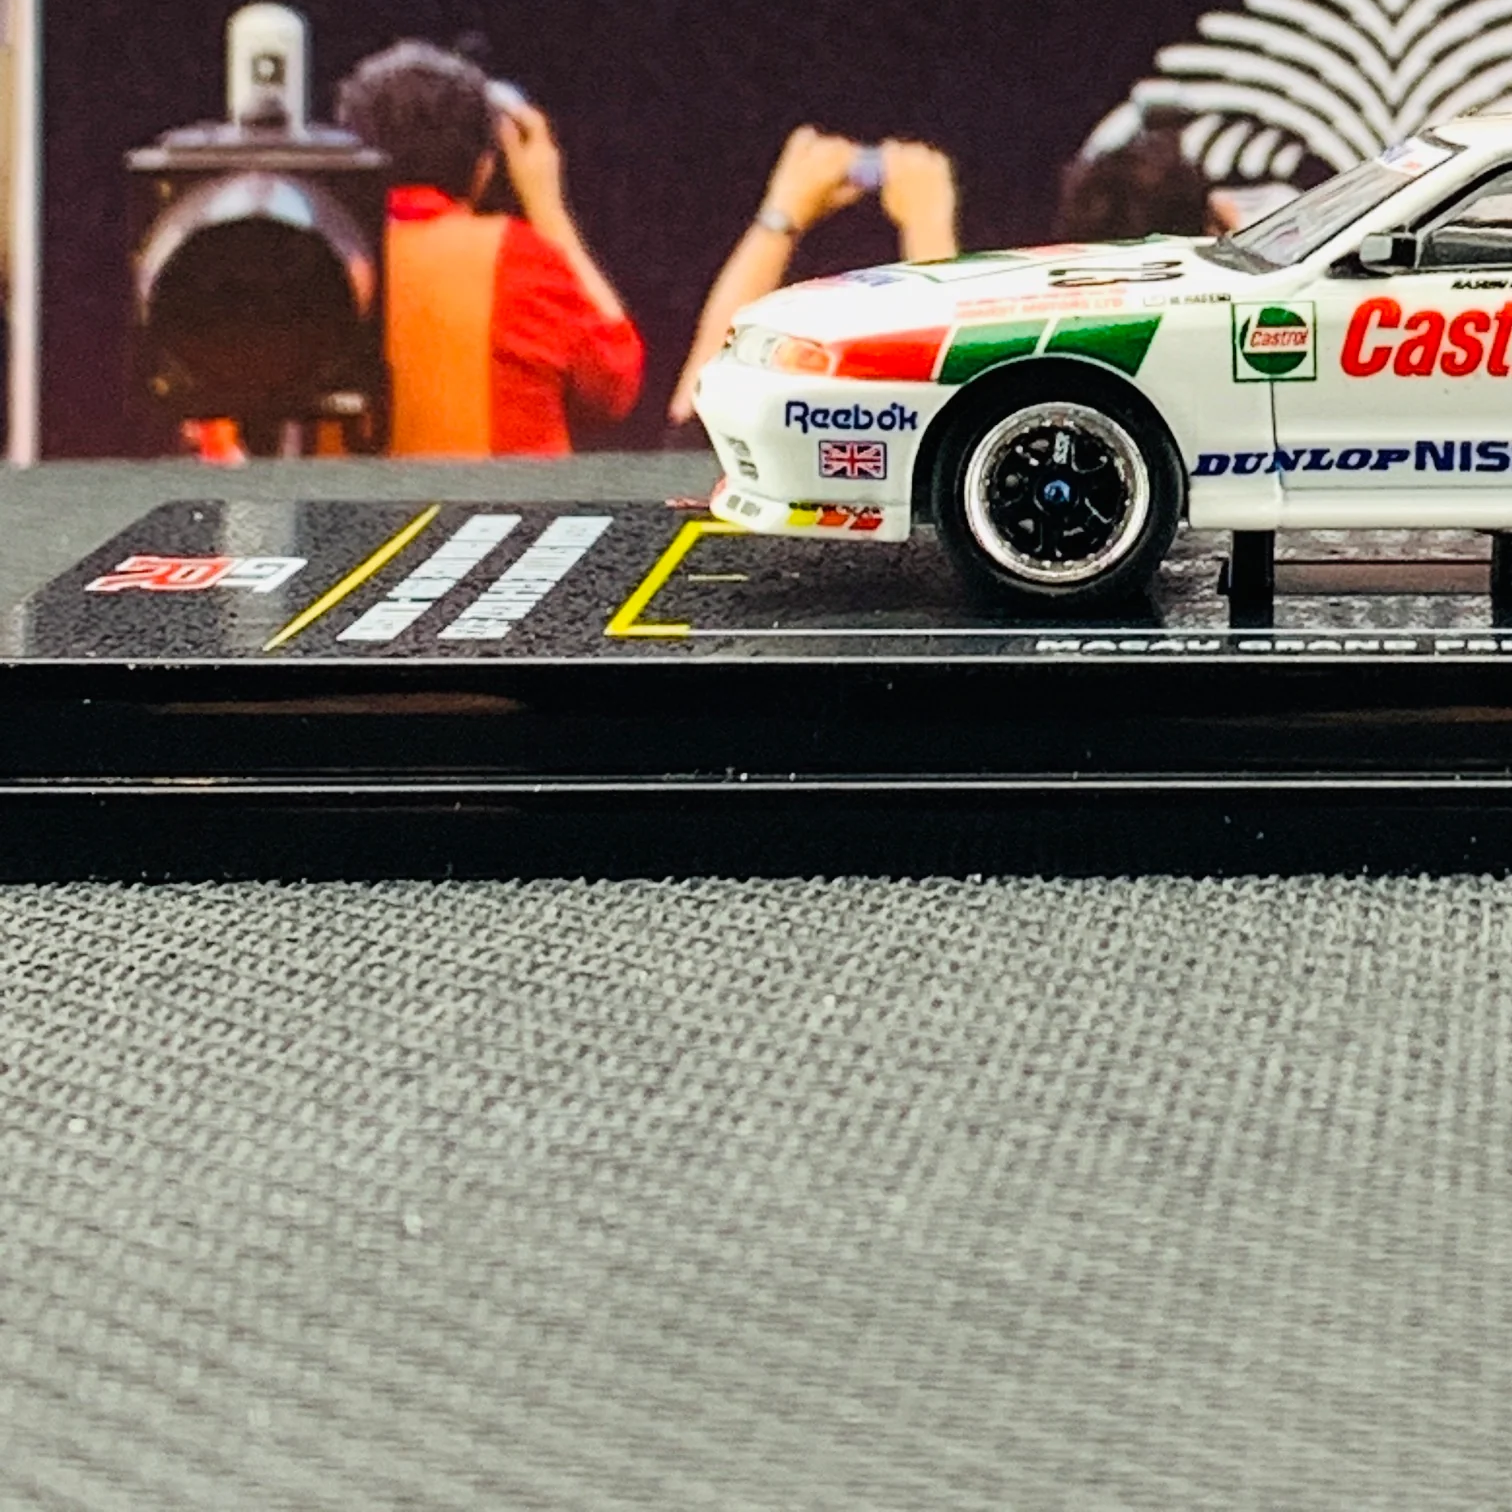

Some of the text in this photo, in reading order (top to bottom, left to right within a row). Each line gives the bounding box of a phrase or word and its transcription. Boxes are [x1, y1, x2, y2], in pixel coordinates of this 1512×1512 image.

[1249, 327, 1309, 348] Castrol
[785, 400, 919, 434] Reebok
[1190, 446, 1413, 477] DUNLOP
[1035, 639, 1221, 651] MACAU
[1238, 639, 1418, 651] GRAND
